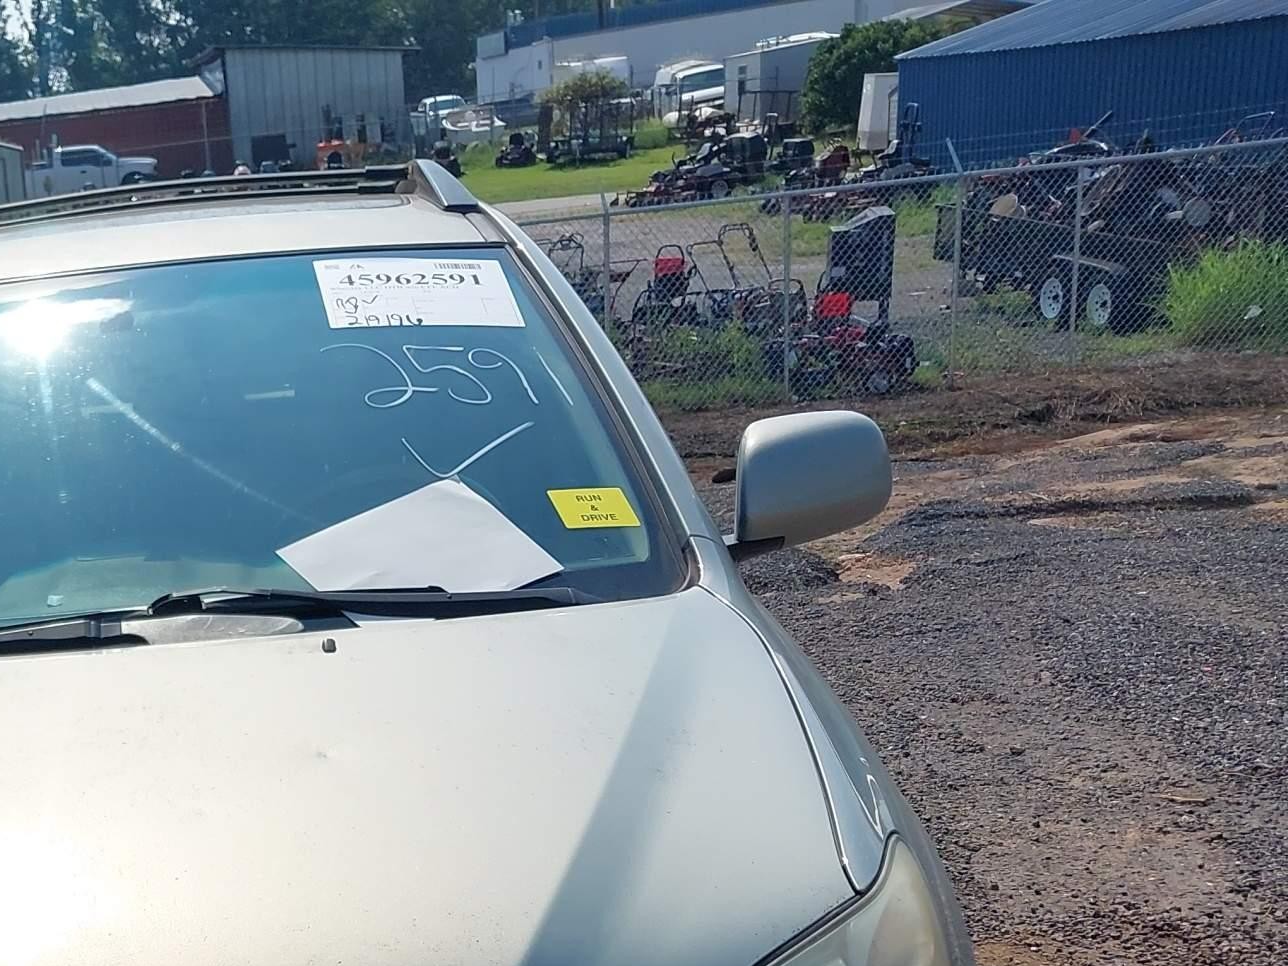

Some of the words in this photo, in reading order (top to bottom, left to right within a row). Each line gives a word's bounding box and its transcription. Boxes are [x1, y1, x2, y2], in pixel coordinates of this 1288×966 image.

[338, 272, 483, 287] 45962591
[320, 343, 574, 408] 2591
[575, 494, 602, 502] RUN
[590, 504, 600, 512] &
[580, 513, 619, 522] DRIVE
